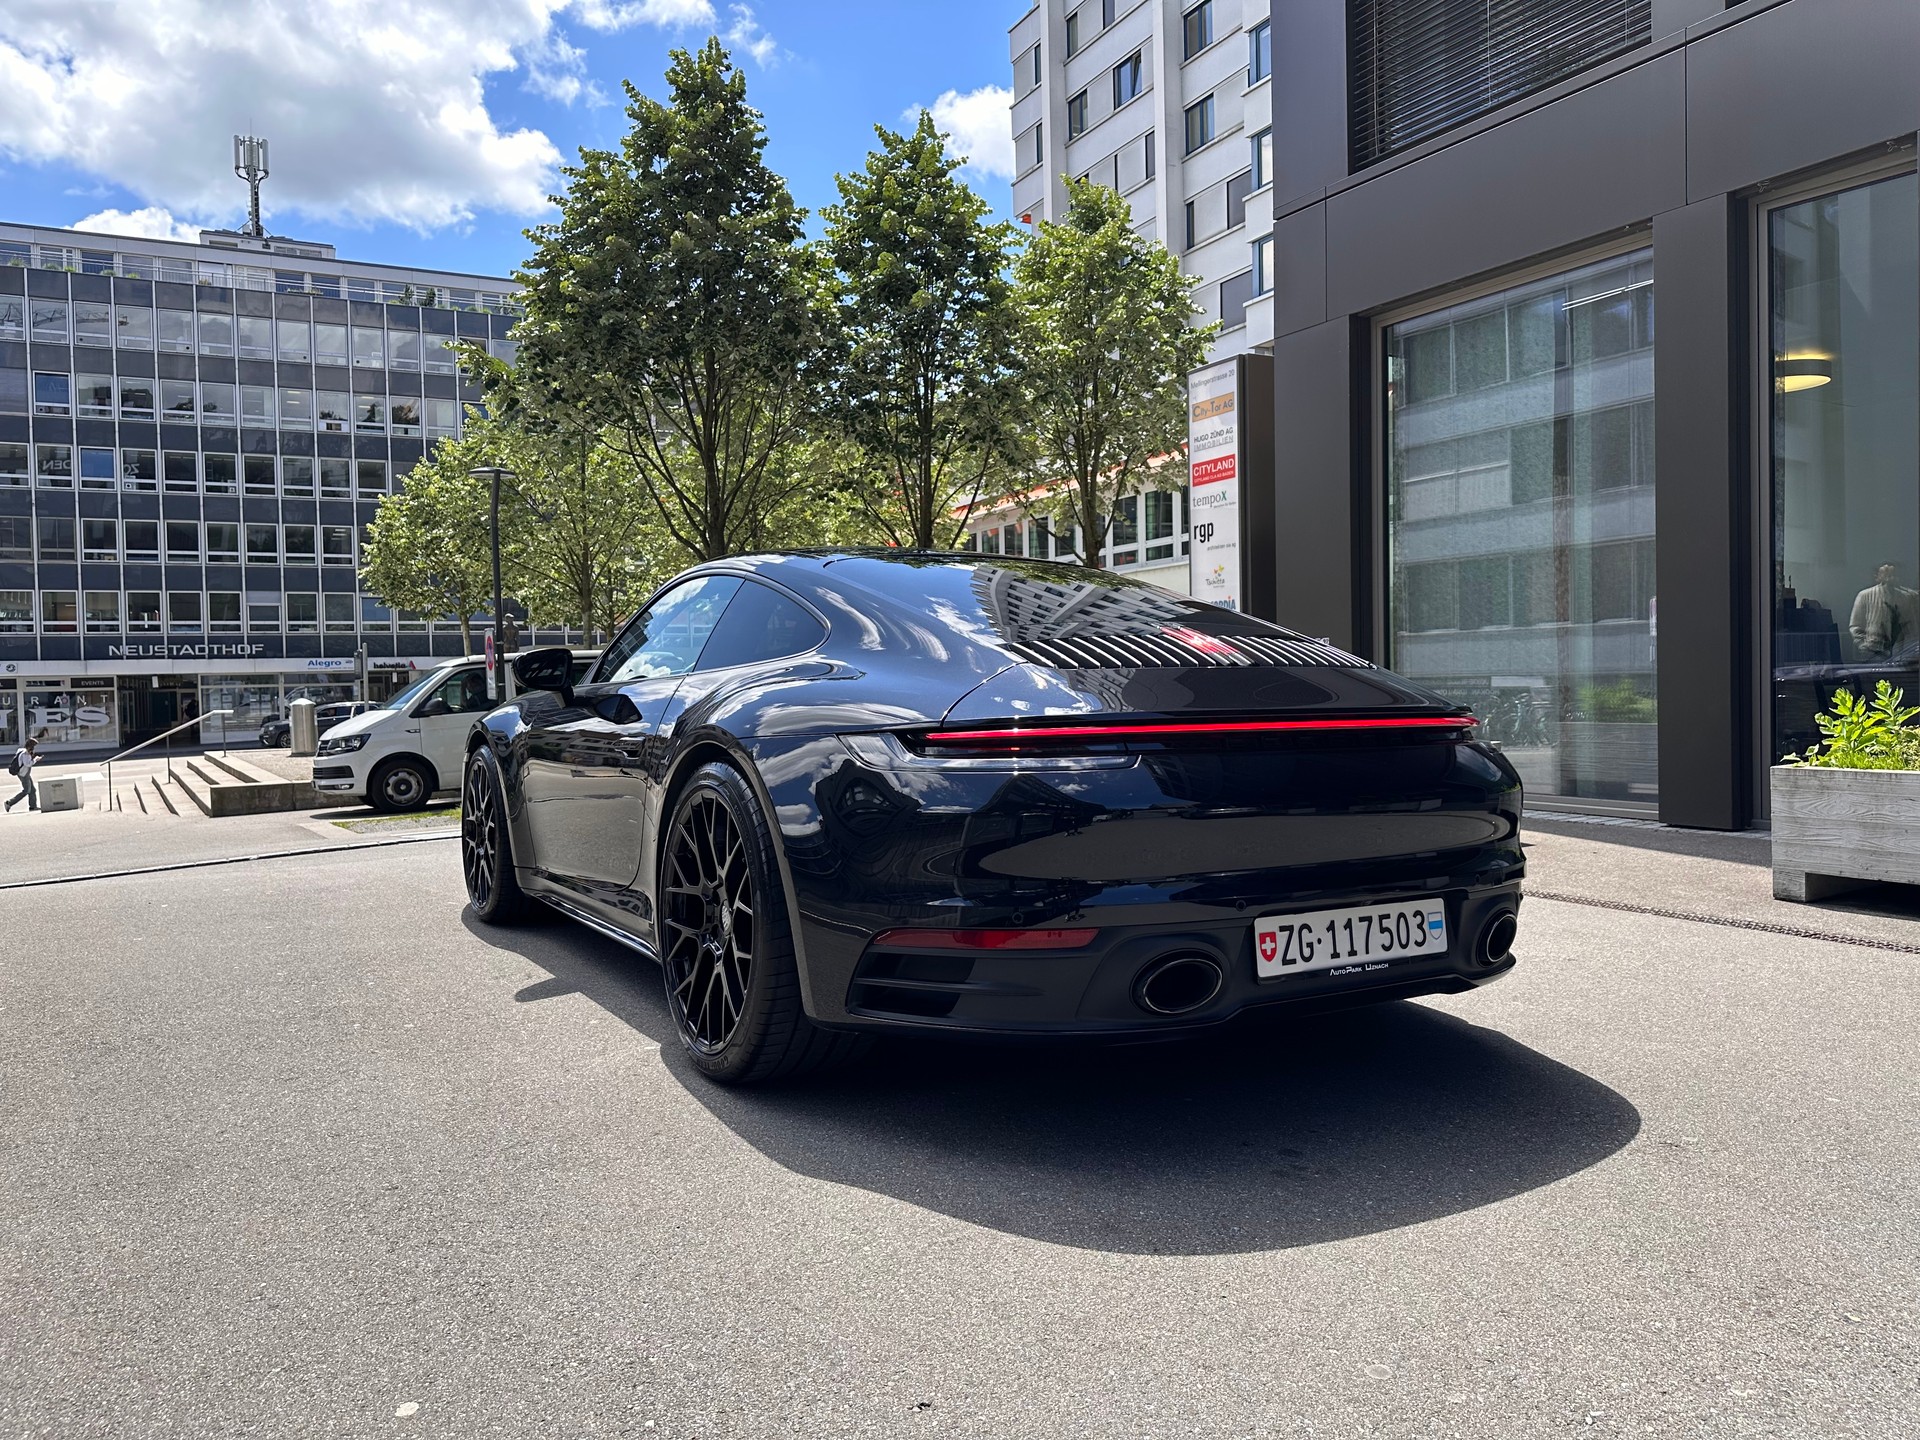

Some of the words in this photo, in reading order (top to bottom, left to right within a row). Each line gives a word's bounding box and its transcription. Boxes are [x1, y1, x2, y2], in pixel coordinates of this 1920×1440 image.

[1223, 399, 1233, 409] AG
[1194, 434, 1209, 443] HUGO
[1194, 458, 1234, 476] CITYLAND
[1193, 522, 1214, 543] rgp
[108, 644, 264, 656] NEUSTADTHOF
[307, 659, 342, 668] Alegro
